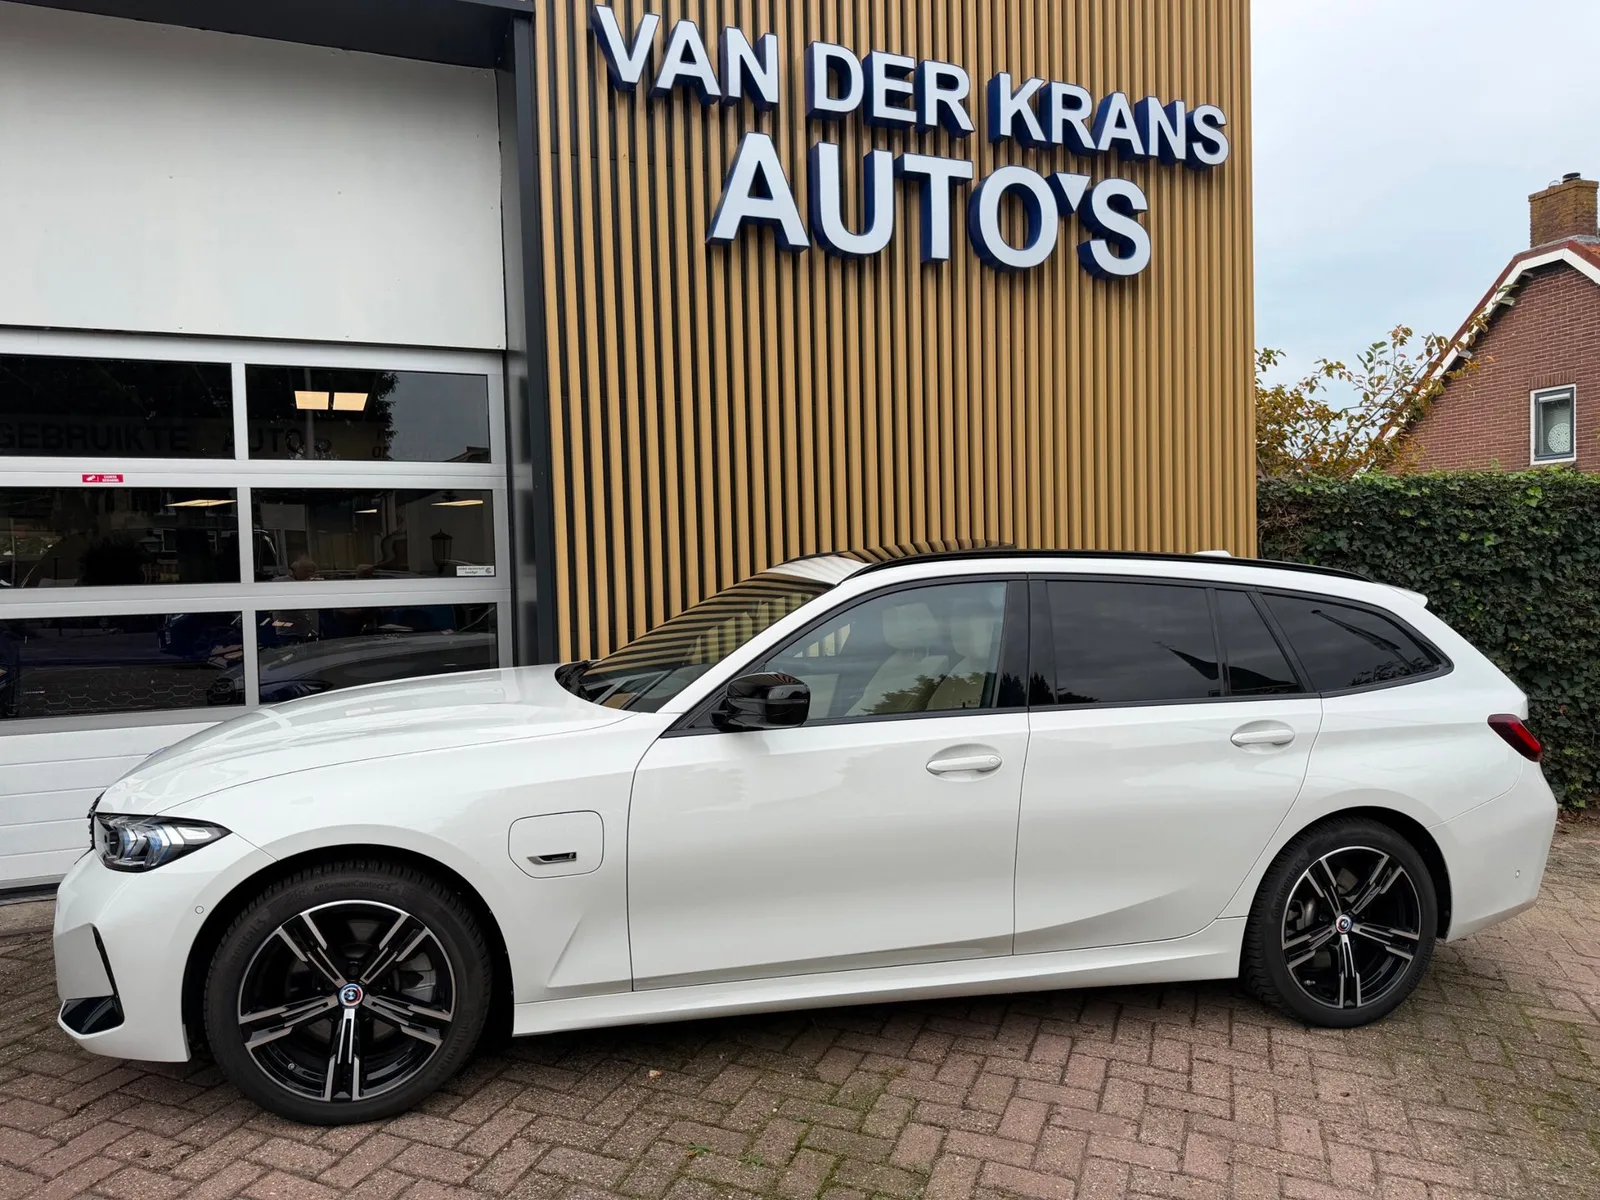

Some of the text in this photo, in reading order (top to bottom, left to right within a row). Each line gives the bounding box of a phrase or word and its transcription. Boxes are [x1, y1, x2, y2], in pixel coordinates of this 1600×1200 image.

[592, 5, 1229, 169] VAN DER KRANS
[706, 132, 1151, 279] AUTO'S
[0, 422, 190, 451] GEBRUIKTE
